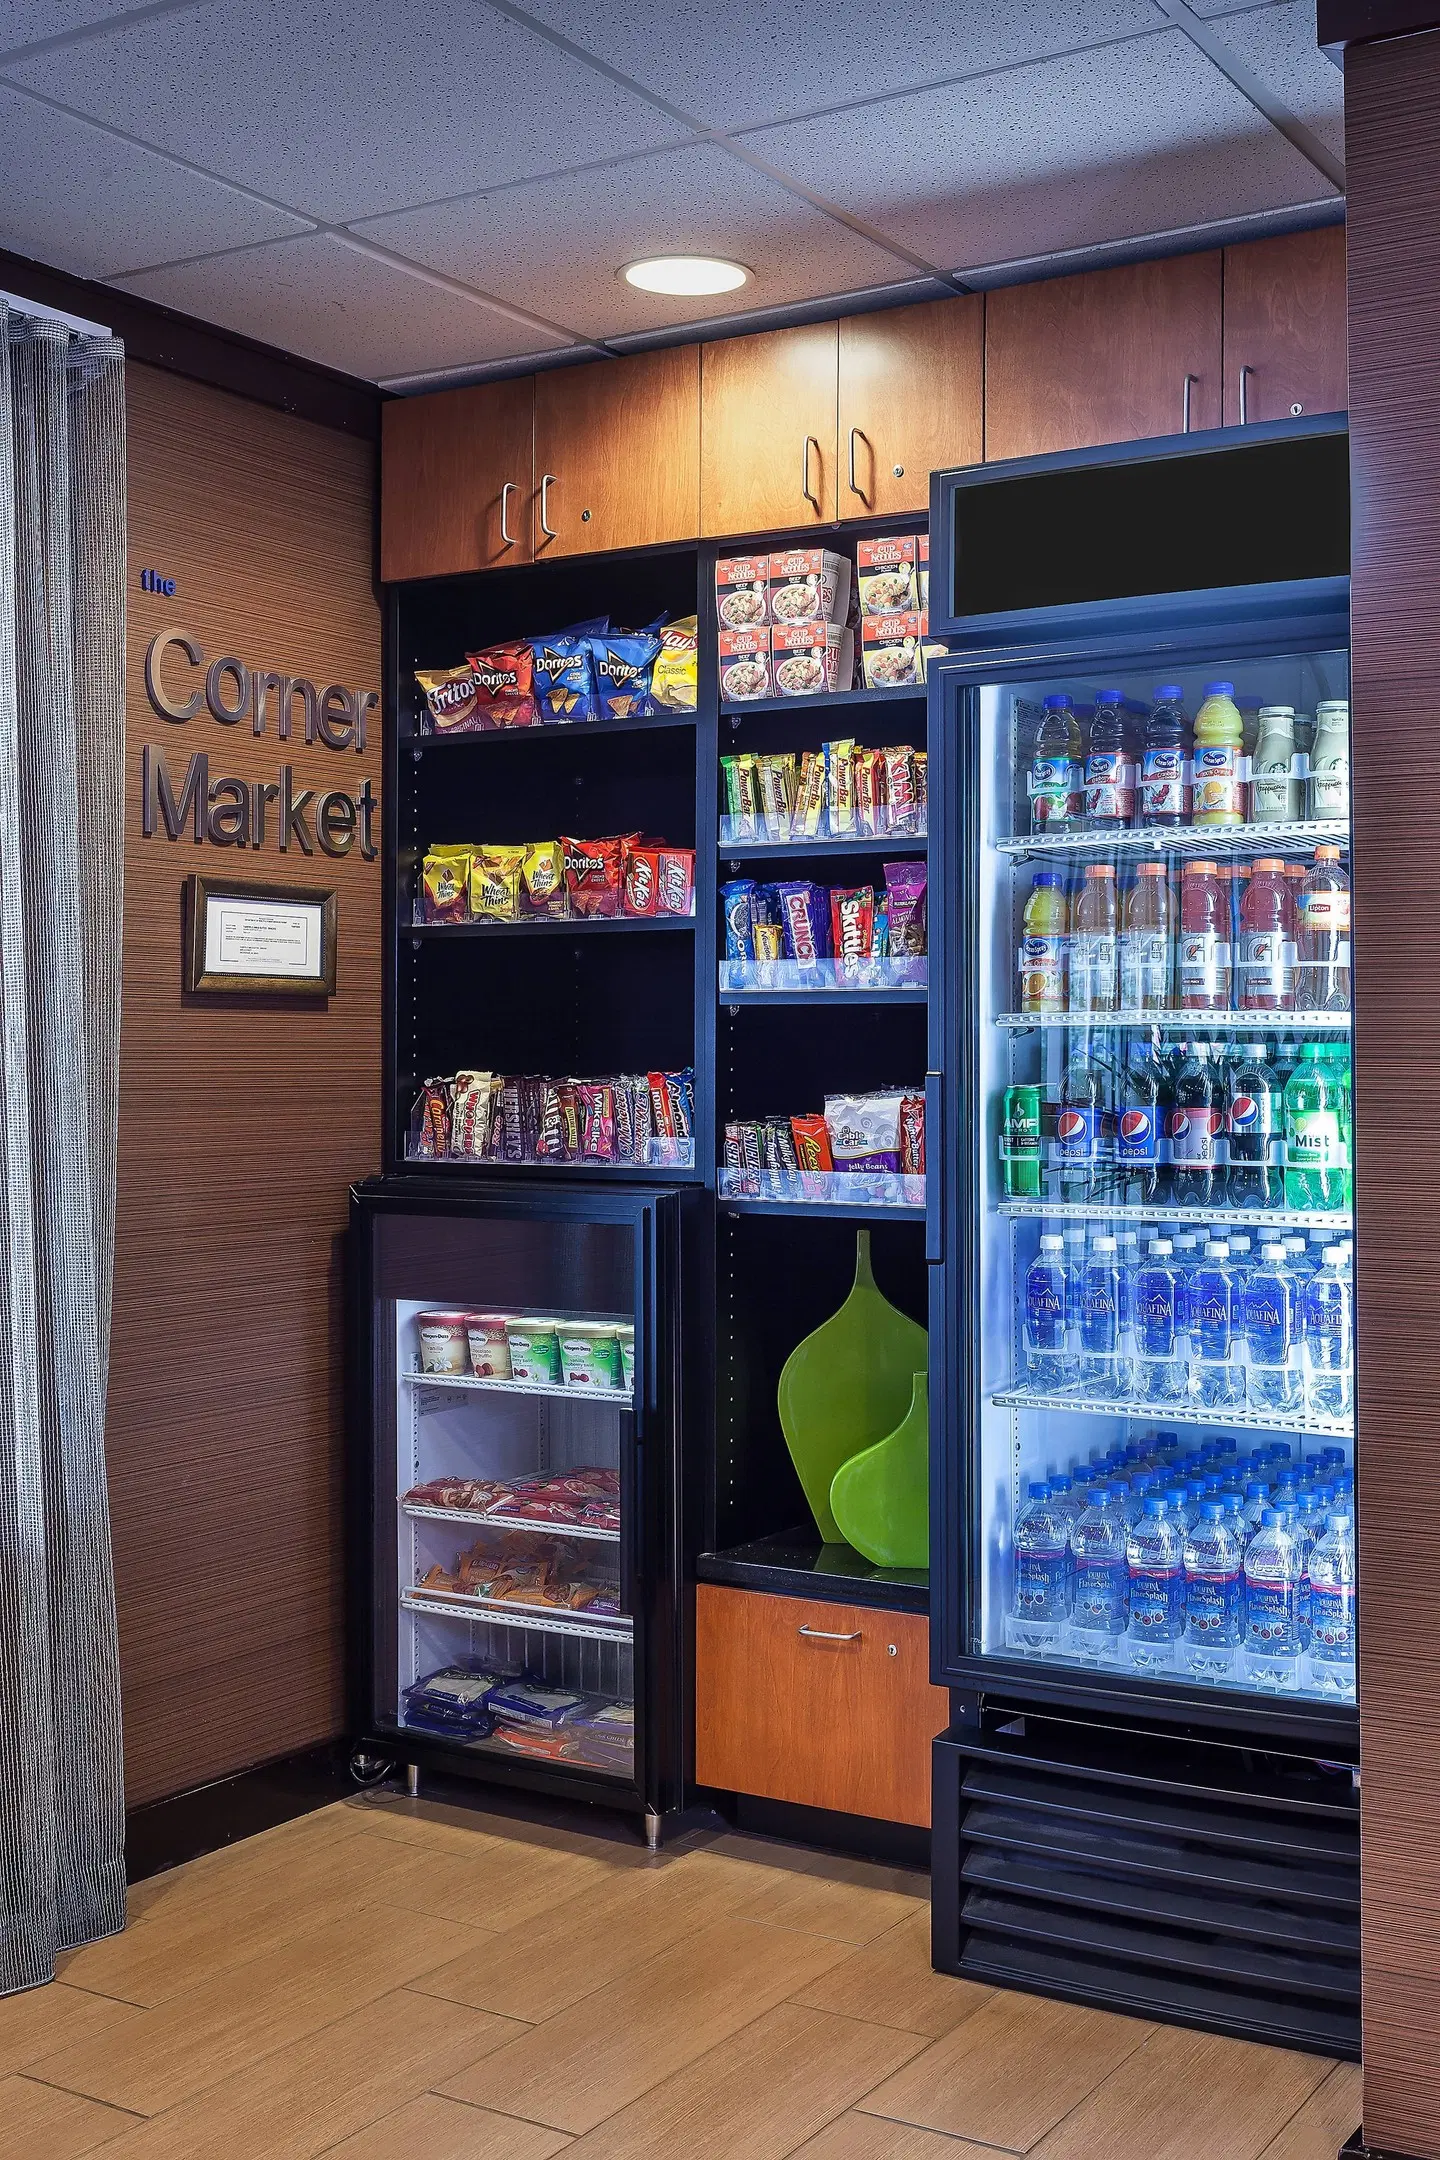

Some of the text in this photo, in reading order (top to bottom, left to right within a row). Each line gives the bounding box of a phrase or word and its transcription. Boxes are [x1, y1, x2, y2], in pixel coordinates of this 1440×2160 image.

[877, 544, 896, 552] CUP
[787, 557, 804, 565] CUP
[871, 551, 902, 562] NOODLES
[727, 570, 756, 581] NOODLES
[781, 563, 810, 574] NOODLES
[140, 567, 176, 596] the
[882, 619, 900, 627] CUP
[790, 629, 808, 637] CUP
[875, 625, 906, 637] NOODLES
[730, 641, 757, 652] NOODLES
[784, 636, 814, 647] NOODLES
[535, 655, 582, 673] Doritos
[599, 662, 643, 677] Doritos
[657, 664, 686, 676] Classic
[473, 672, 517, 685] Doritos
[144, 628, 379, 753] Corner
[427, 679, 476, 715] Fritos
[810, 764, 825, 809] PowerBar
[839, 758, 849, 808] PowerBar
[862, 767, 872, 813] PowerBar
[889, 755, 916, 824] TWIX
[740, 768, 752, 817] PowerBar
[773, 770, 787, 820] PowerBar
[142, 744, 378, 861] Market
[564, 856, 605, 870] Doritos
[531, 870, 555, 881] Wheat
[437, 882, 455, 892] Wheat
[482, 884, 510, 898] Wheat
[530, 879, 554, 889] Thins
[436, 890, 454, 899] Thins
[480, 895, 509, 907] Thins
[760, 931, 772, 961] Newtons
[841, 901, 859, 978] Skittles
[666, 1080, 688, 1139] Almond
[463, 1091, 480, 1155] WHOPPERS
[503, 1088, 523, 1159] HERSHEY'S
[591, 1093, 603, 1152] Mike Ike
[652, 1091, 671, 1152] 100 GRAND
[1004, 1118, 1039, 1128] AMP
[837, 1131, 865, 1140] Cable
[1295, 1134, 1330, 1147] Mist
[744, 1130, 760, 1185] SNICKERS
[1060, 1147, 1084, 1157] pepsi
[1122, 1147, 1148, 1157] pepsi
[726, 1140, 741, 1193] SNICKERS
[766, 1141, 781, 1191] Milky Way
[777, 1137, 798, 1182] Milky Way
[848, 1163, 864, 1172] Jelly
